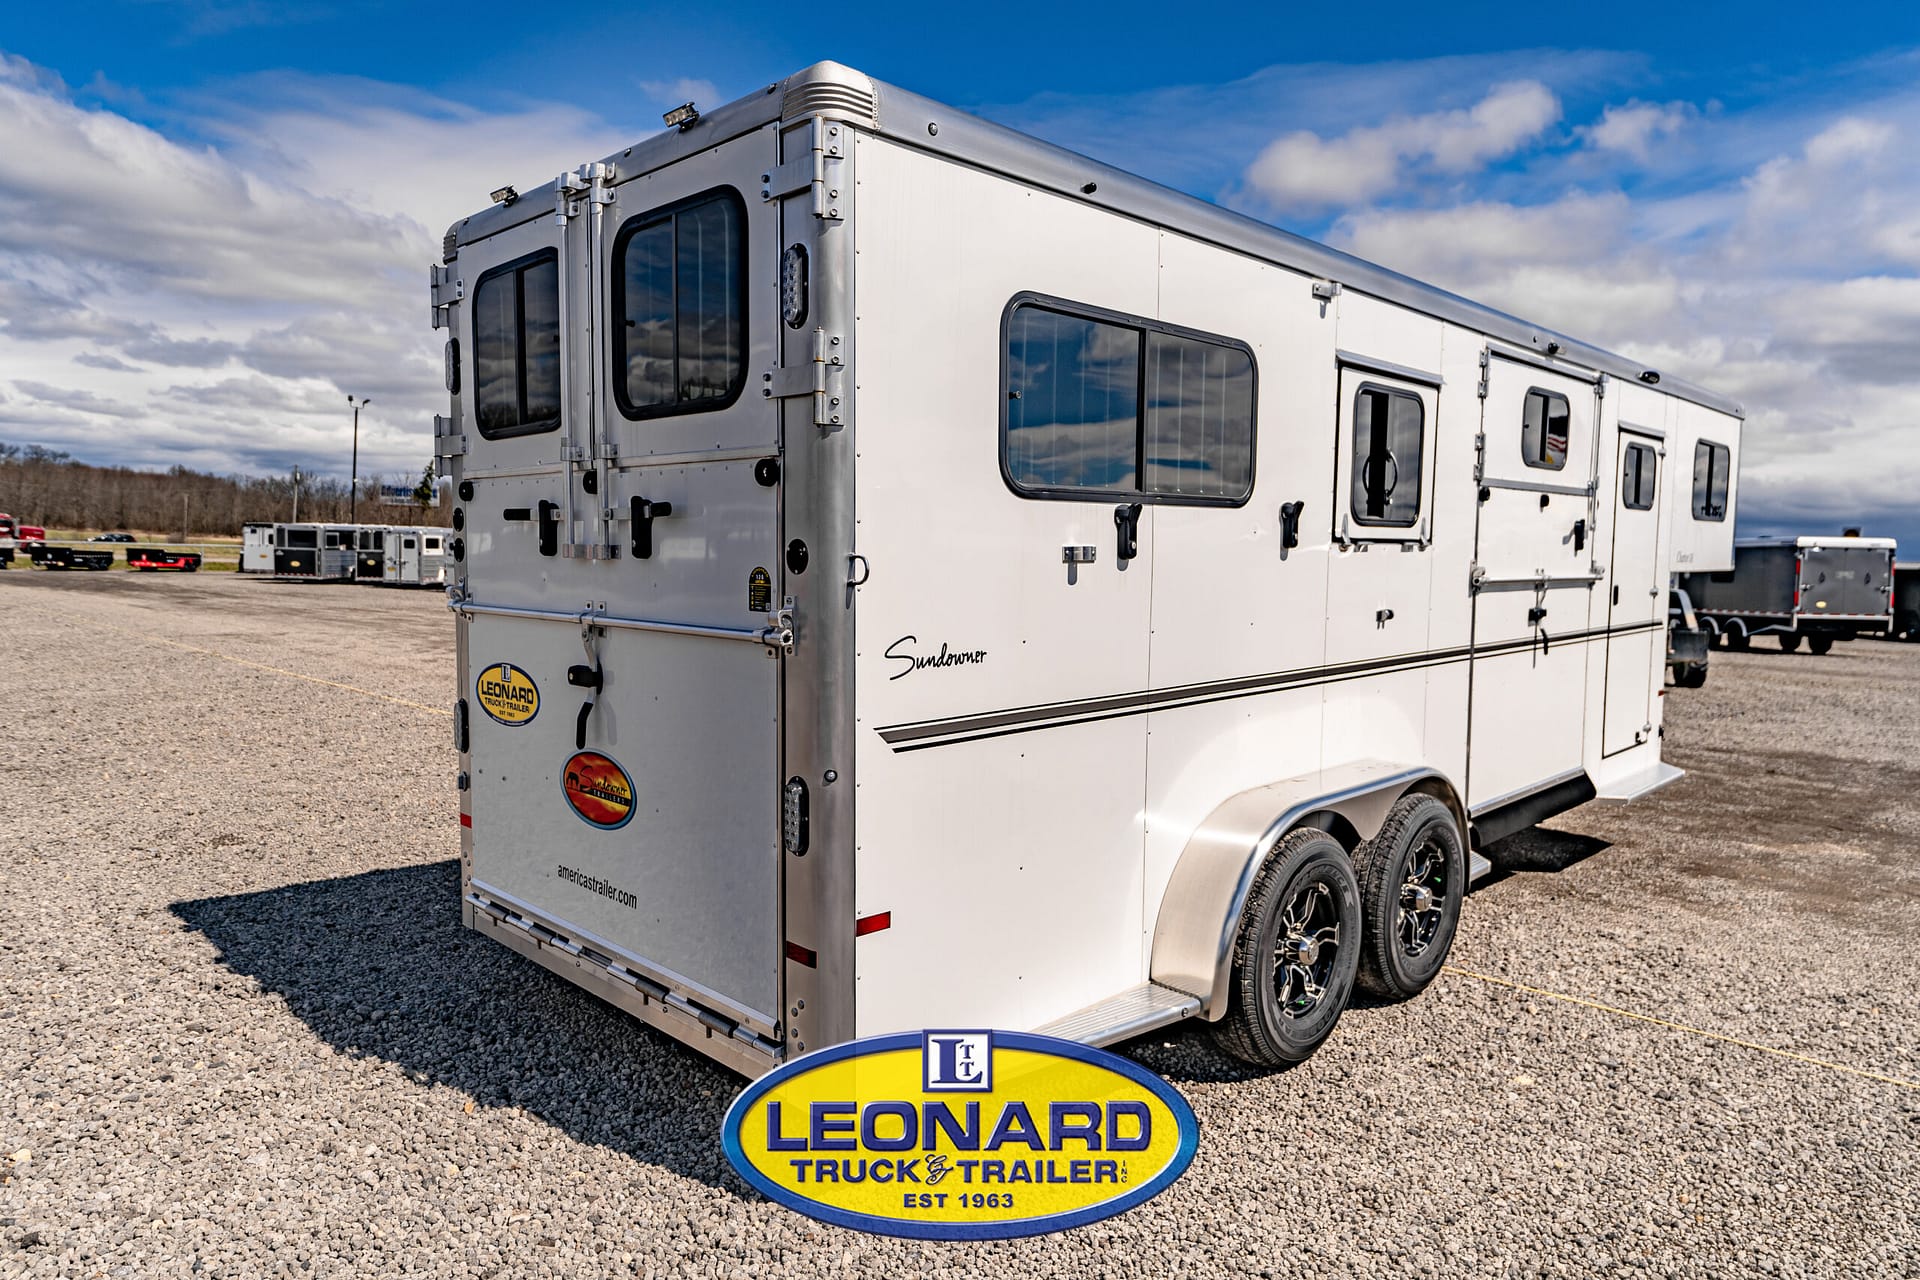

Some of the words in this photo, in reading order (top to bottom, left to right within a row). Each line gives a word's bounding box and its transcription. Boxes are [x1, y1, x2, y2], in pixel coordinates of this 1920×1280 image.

[884, 635, 988, 681] Sundowner
[481, 680, 534, 705] LEONARD
[485, 697, 501, 707] TRUCK
[506, 701, 530, 713] TRAILER
[579, 766, 628, 796] Sundowner
[557, 864, 638, 910] americastrailer.com
